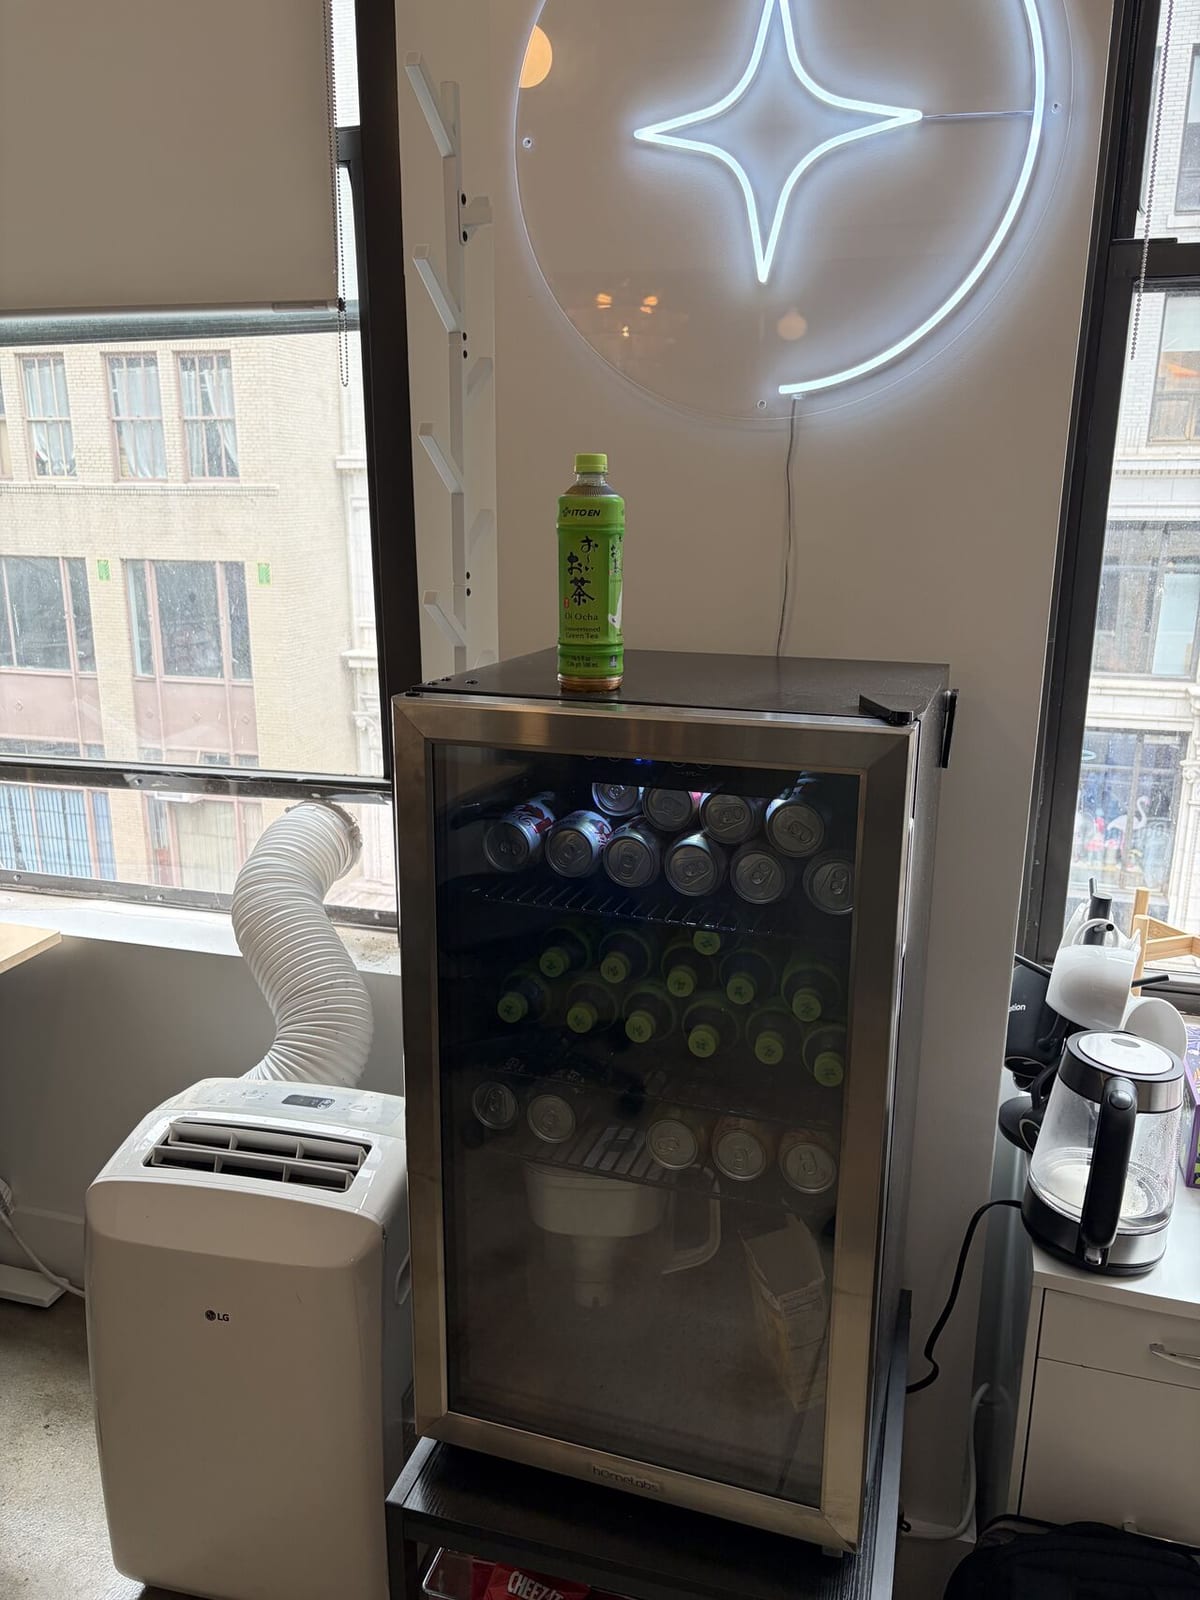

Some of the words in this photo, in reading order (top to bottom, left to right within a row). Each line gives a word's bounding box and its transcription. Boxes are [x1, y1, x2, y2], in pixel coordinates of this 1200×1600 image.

[571, 508, 587, 517] ITO
[587, 508, 601, 517] EN
[566, 551, 596, 607] お茶
[574, 612, 599, 621] Ocha
[217, 1312, 230, 1322] LG
